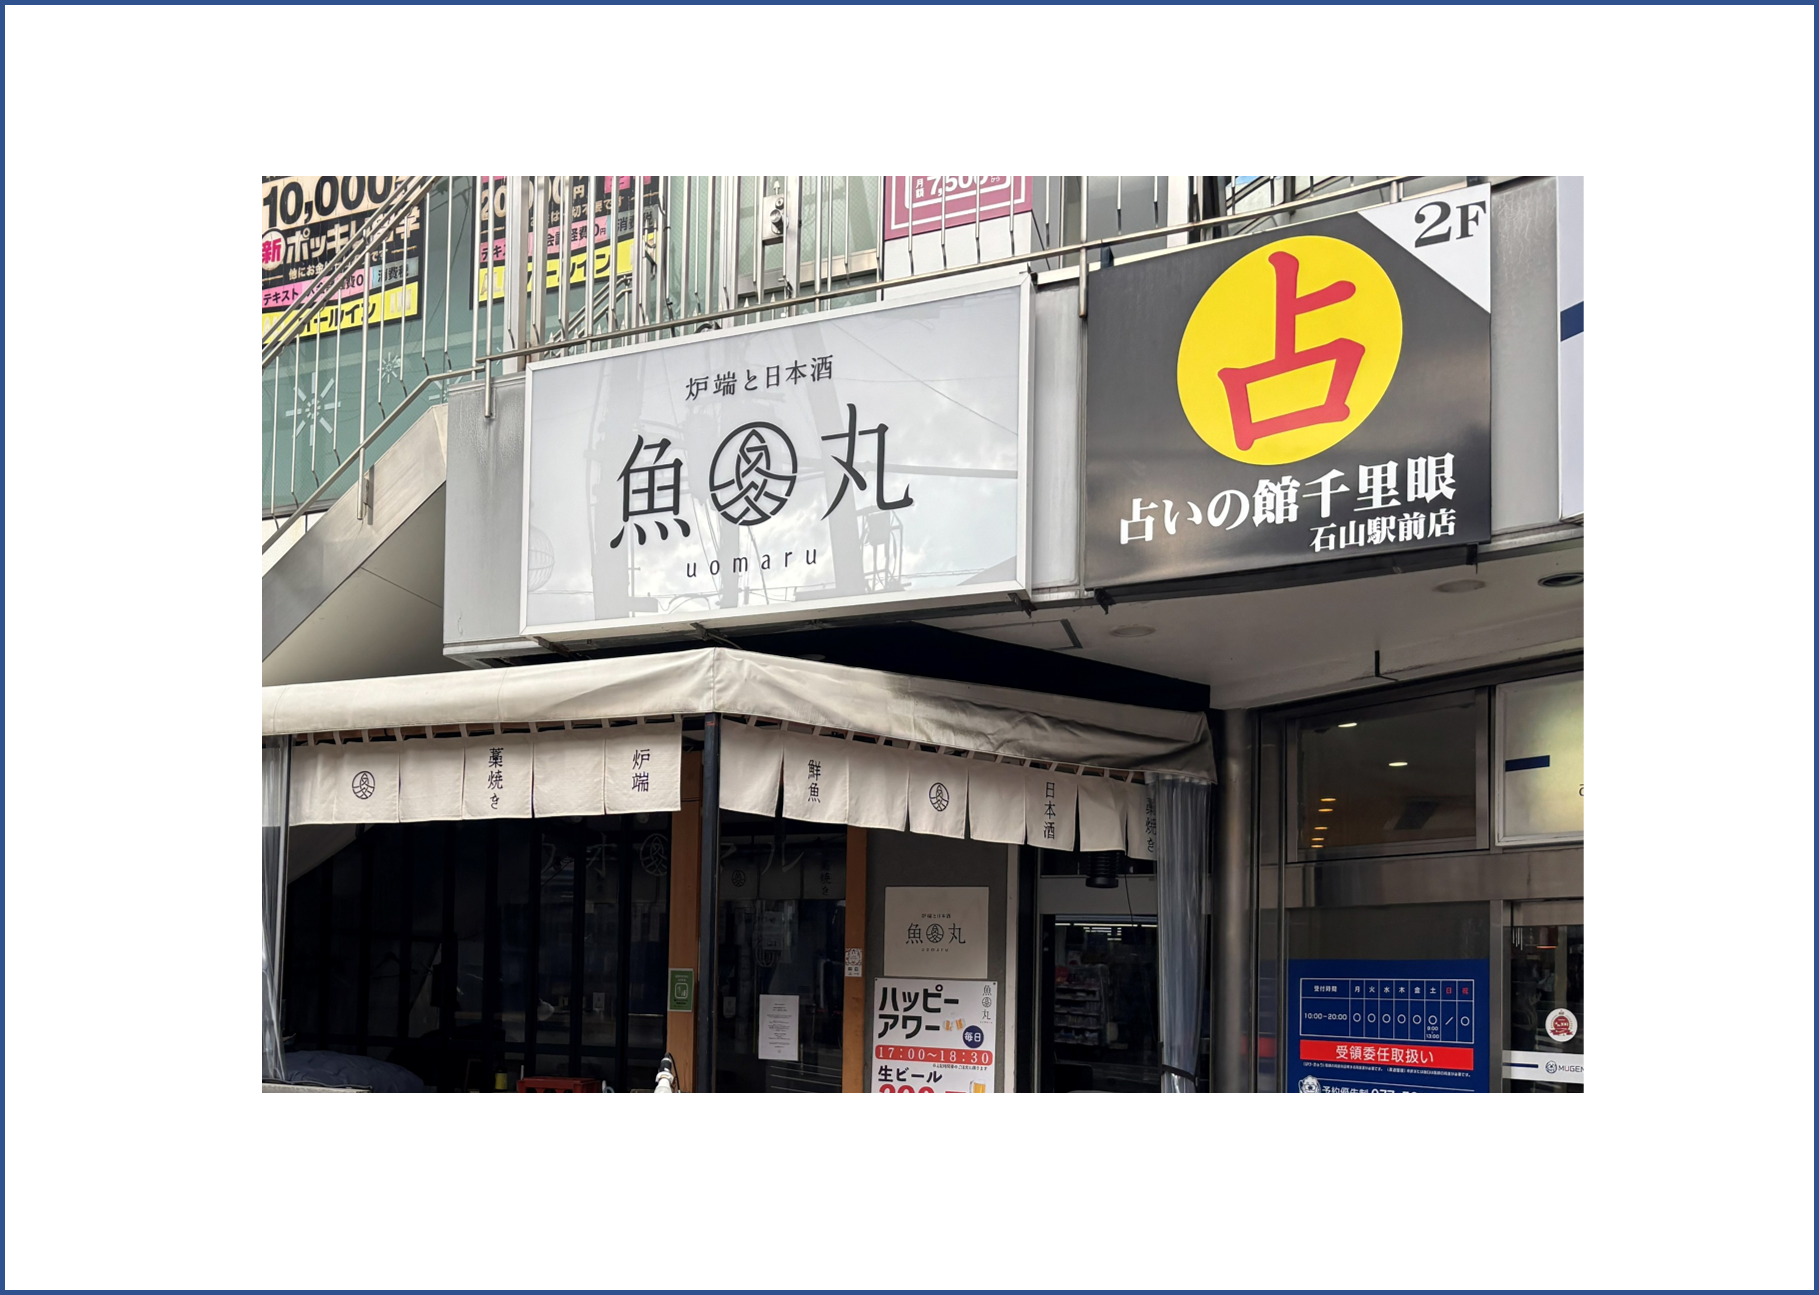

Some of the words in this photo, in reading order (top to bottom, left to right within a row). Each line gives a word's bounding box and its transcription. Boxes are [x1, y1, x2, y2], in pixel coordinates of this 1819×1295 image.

[1414, 200, 1487, 249] 2F
[263, 288, 299, 305] テキスト
[1217, 250, 1366, 451] 占
[686, 354, 834, 401] 炉端と日本酒
[1119, 452, 1457, 545] 占いの館千里眼
[1309, 508, 1457, 552] 石山駅前店
[686, 548, 818, 578] uomaru
[487, 747, 504, 810] 藁焼き
[632, 748, 651, 793] 炉端
[807, 758, 822, 804] 鮮魚
[1043, 781, 1056, 840] 日本酒
[879, 984, 959, 1013] ハッピー
[878, 1014, 940, 1039] アワー
[964, 1030, 981, 1042] 毎日
[878, 1065, 943, 1084] 生ビール
[1335, 1045, 1434, 1064] 受領委任取扱い
